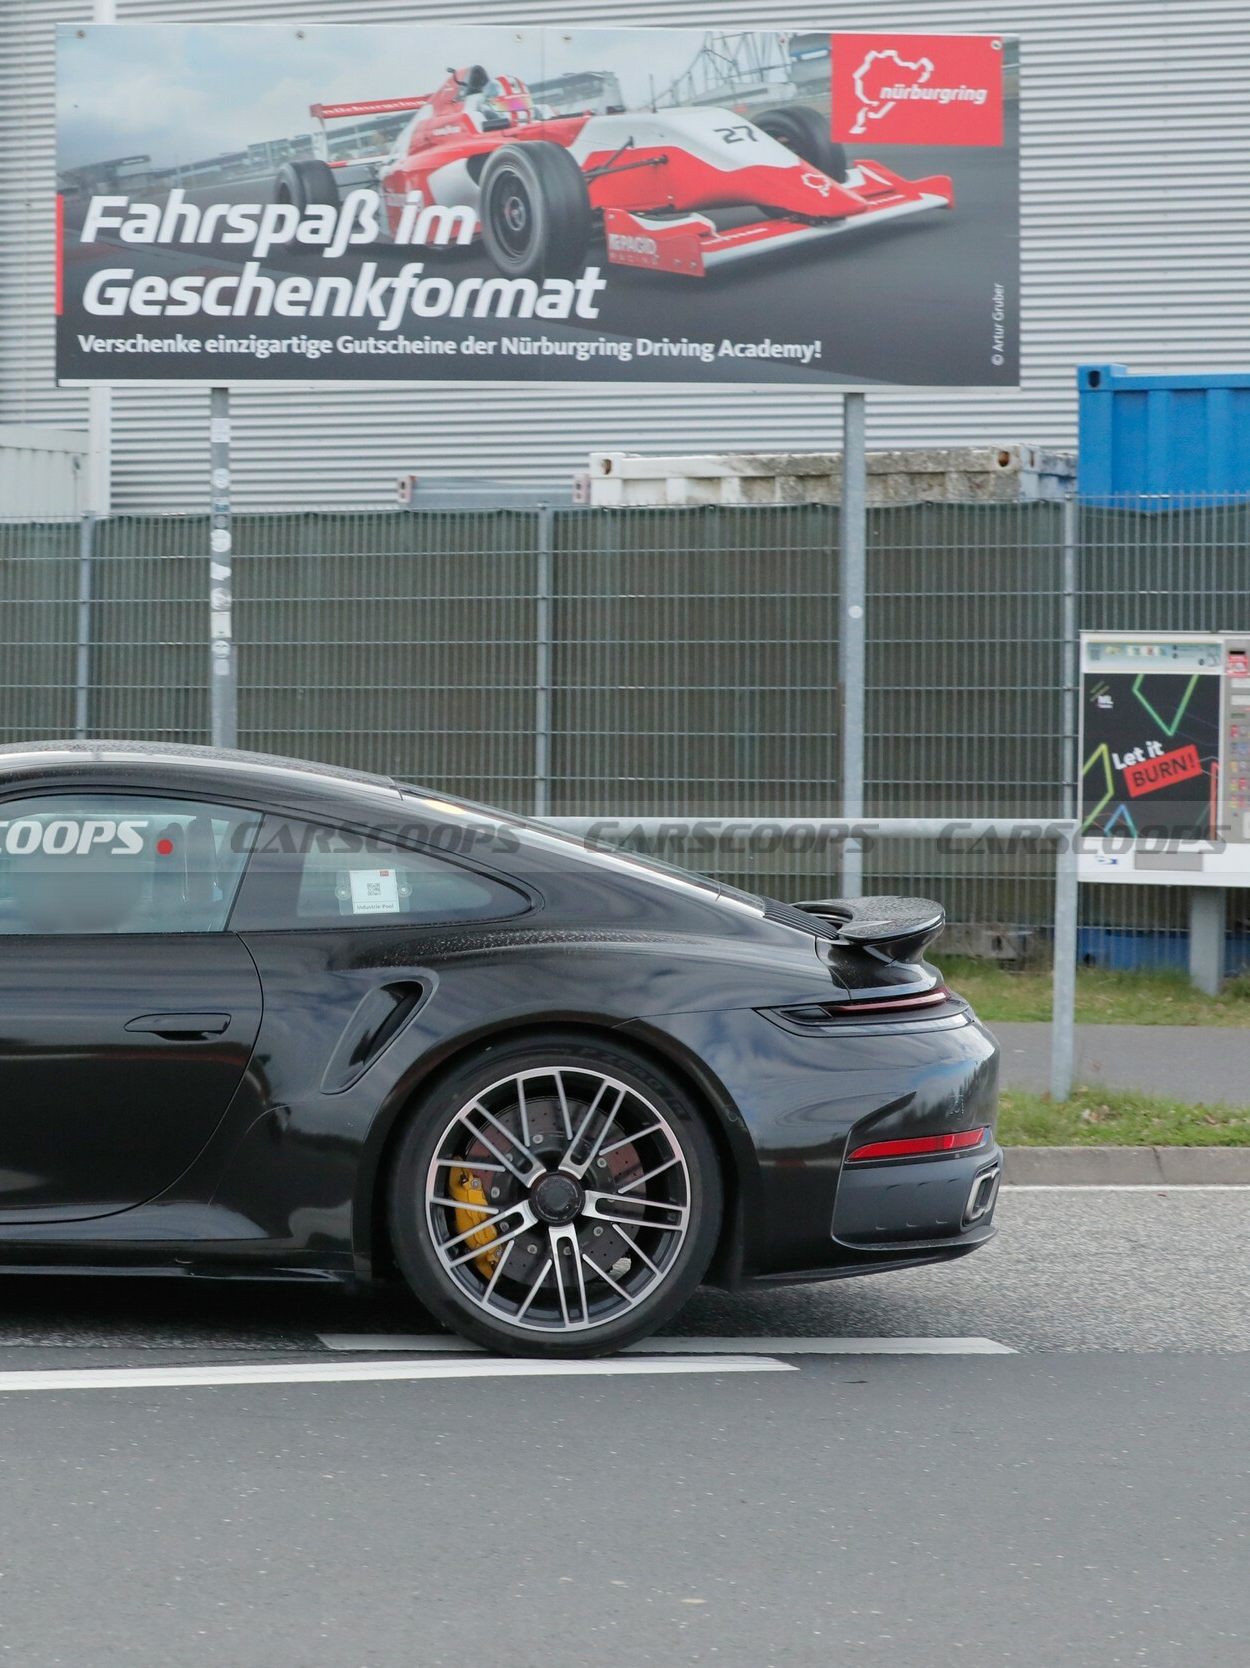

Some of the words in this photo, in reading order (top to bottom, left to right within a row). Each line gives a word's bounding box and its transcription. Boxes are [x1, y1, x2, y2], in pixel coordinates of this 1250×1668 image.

[879, 82, 988, 105] nürburgring
[713, 123, 758, 145] 27
[79, 188, 381, 259] Fahrspaß
[393, 189, 478, 246] im
[82, 261, 607, 332] Geschenkformat
[991, 282, 1005, 322] Gruber
[76, 333, 202, 354] Verschenke
[203, 333, 333, 359] einzigartige
[336, 334, 458, 355] Gutscheine
[460, 336, 498, 356] der
[500, 335, 633, 362] Nürburgring
[636, 337, 715, 363] Driving
[717, 338, 823, 364] Academy!
[991, 322, 1005, 353] Artur
[1111, 747, 1148, 771] Let
[1146, 740, 1166, 759] it
[1131, 753, 1197, 789] BURN!
